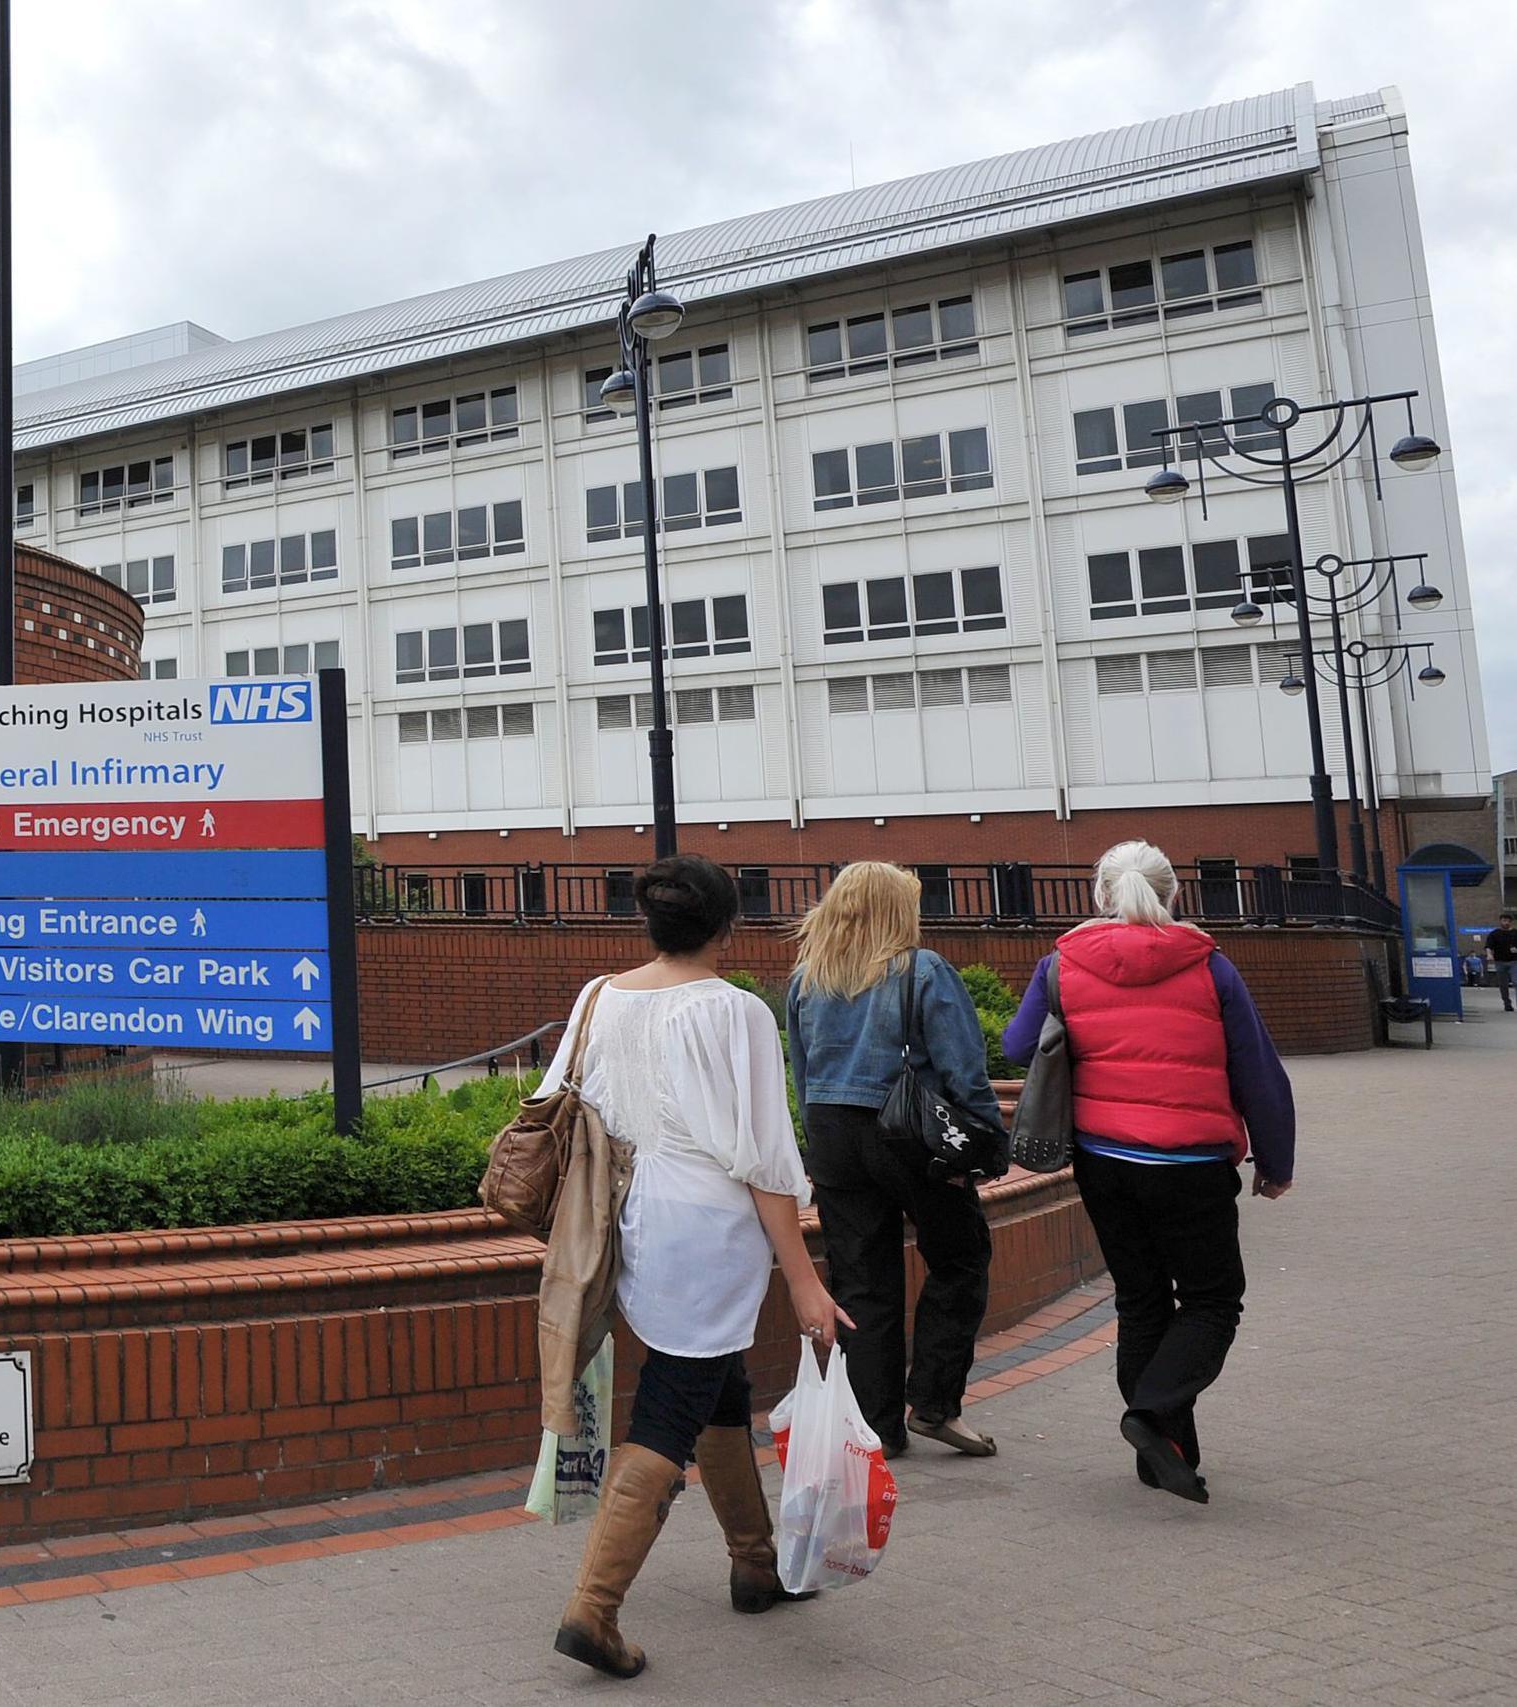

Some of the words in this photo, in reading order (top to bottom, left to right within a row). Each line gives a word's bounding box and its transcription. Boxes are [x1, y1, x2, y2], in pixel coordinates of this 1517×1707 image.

[79, 698, 203, 727] Hospitals
[212, 684, 308, 721] NHS
[143, 731, 169, 742] NHS
[172, 731, 202, 742] Trust
[71, 757, 225, 790] Infirmary
[14, 812, 186, 841] Emergency
[39, 908, 178, 935] Entrance
[129, 957, 185, 985] Car
[199, 959, 271, 986] Park
[196, 1008, 274, 1042] Wing
